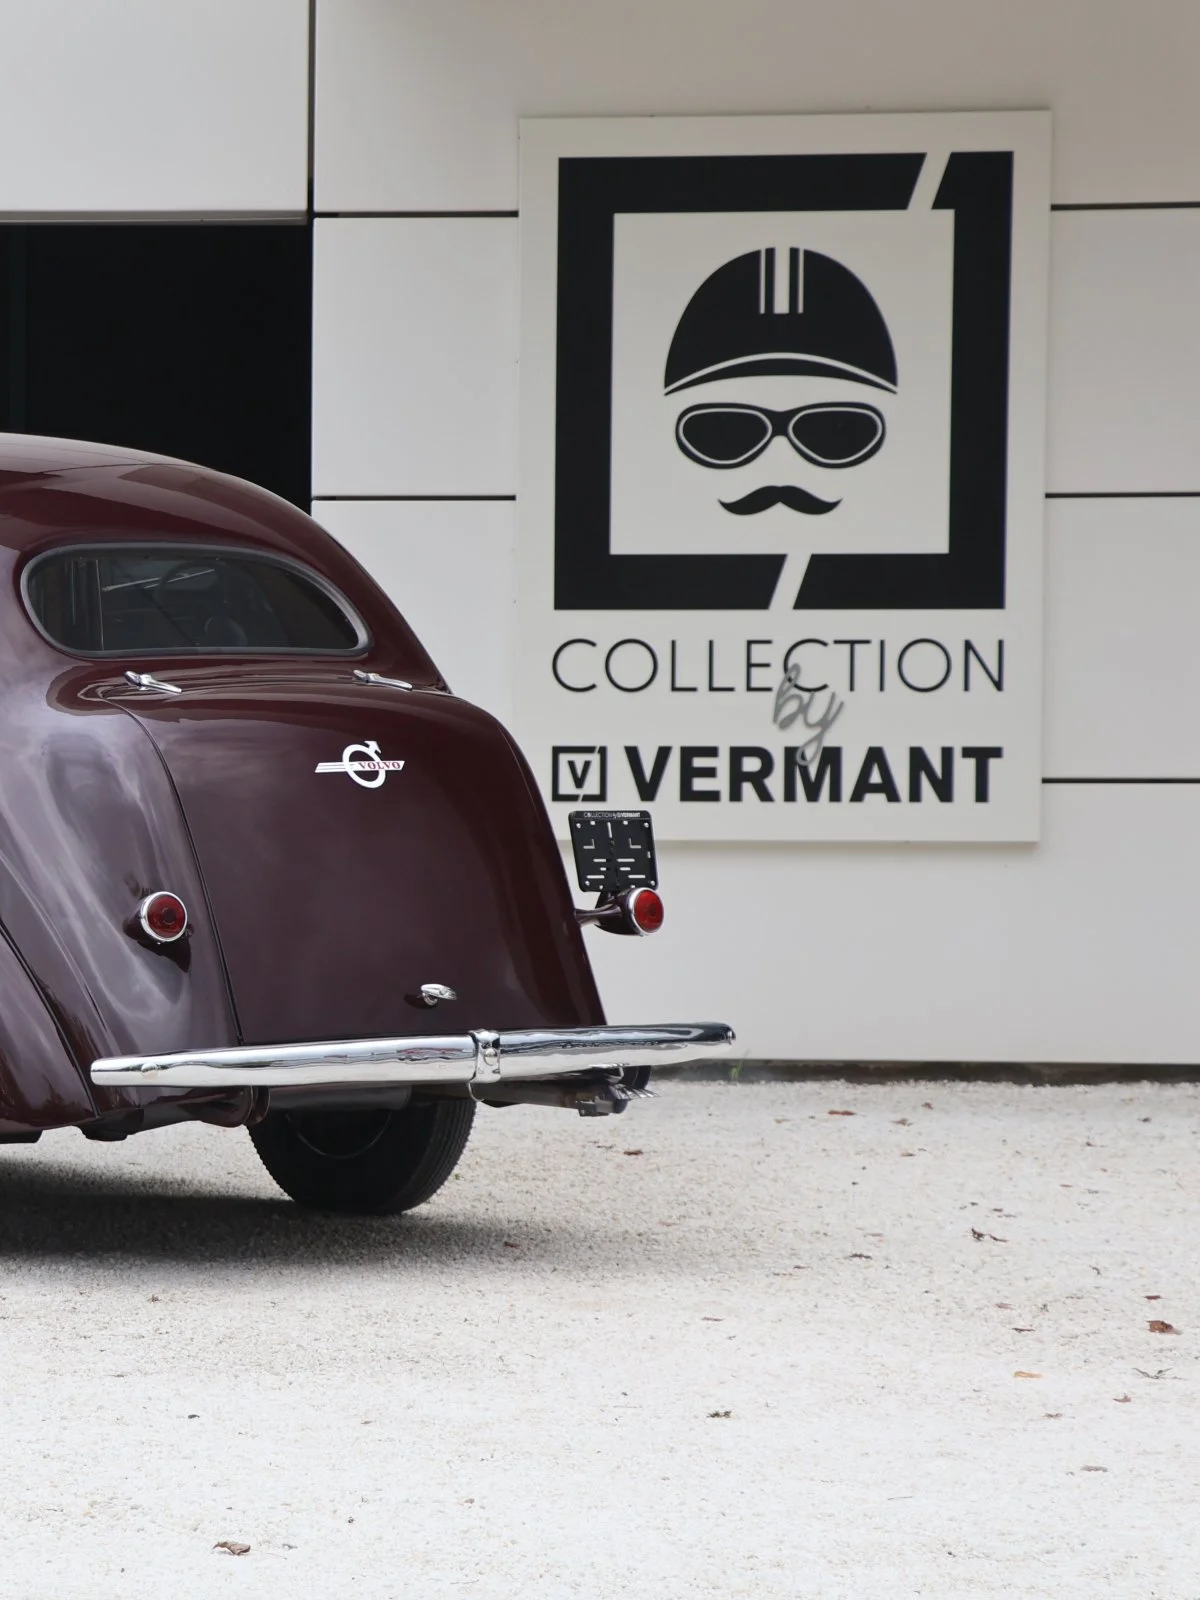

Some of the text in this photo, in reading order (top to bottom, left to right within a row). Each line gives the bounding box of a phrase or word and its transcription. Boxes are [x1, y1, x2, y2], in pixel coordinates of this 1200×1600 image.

[552, 638, 1005, 693] COLLECTION
[773, 663, 844, 766] by
[358, 761, 401, 770] VOLVO
[623, 745, 1003, 803] VERMANT
